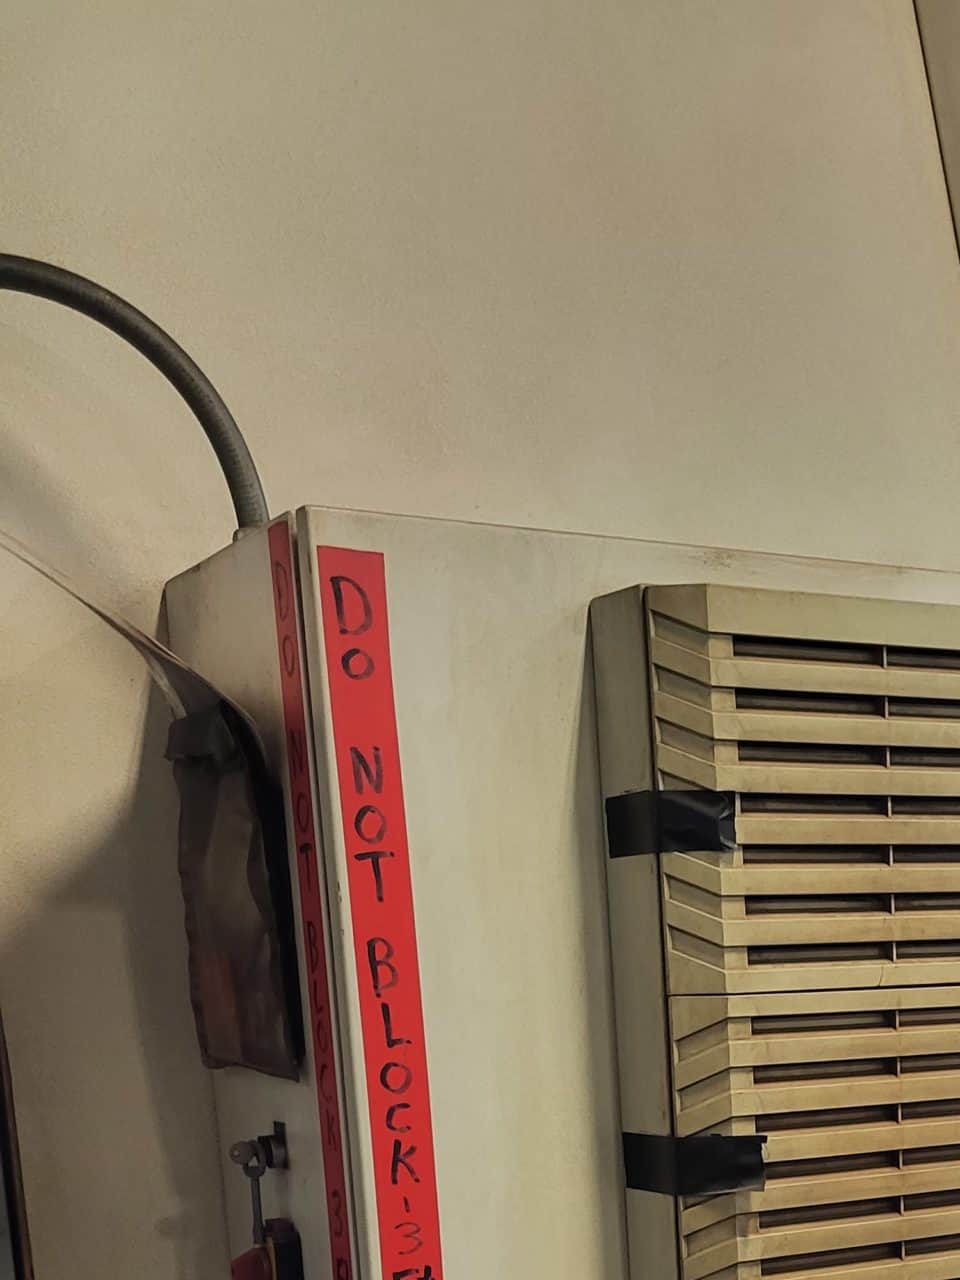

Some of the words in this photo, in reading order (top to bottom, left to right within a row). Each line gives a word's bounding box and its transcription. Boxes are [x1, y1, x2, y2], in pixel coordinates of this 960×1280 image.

[289, 727, 313, 888] NOT
[306, 920, 338, 1151] BLOCK
[349, 745, 395, 902] NOT
[366, 937, 421, 1185] BLOCK
